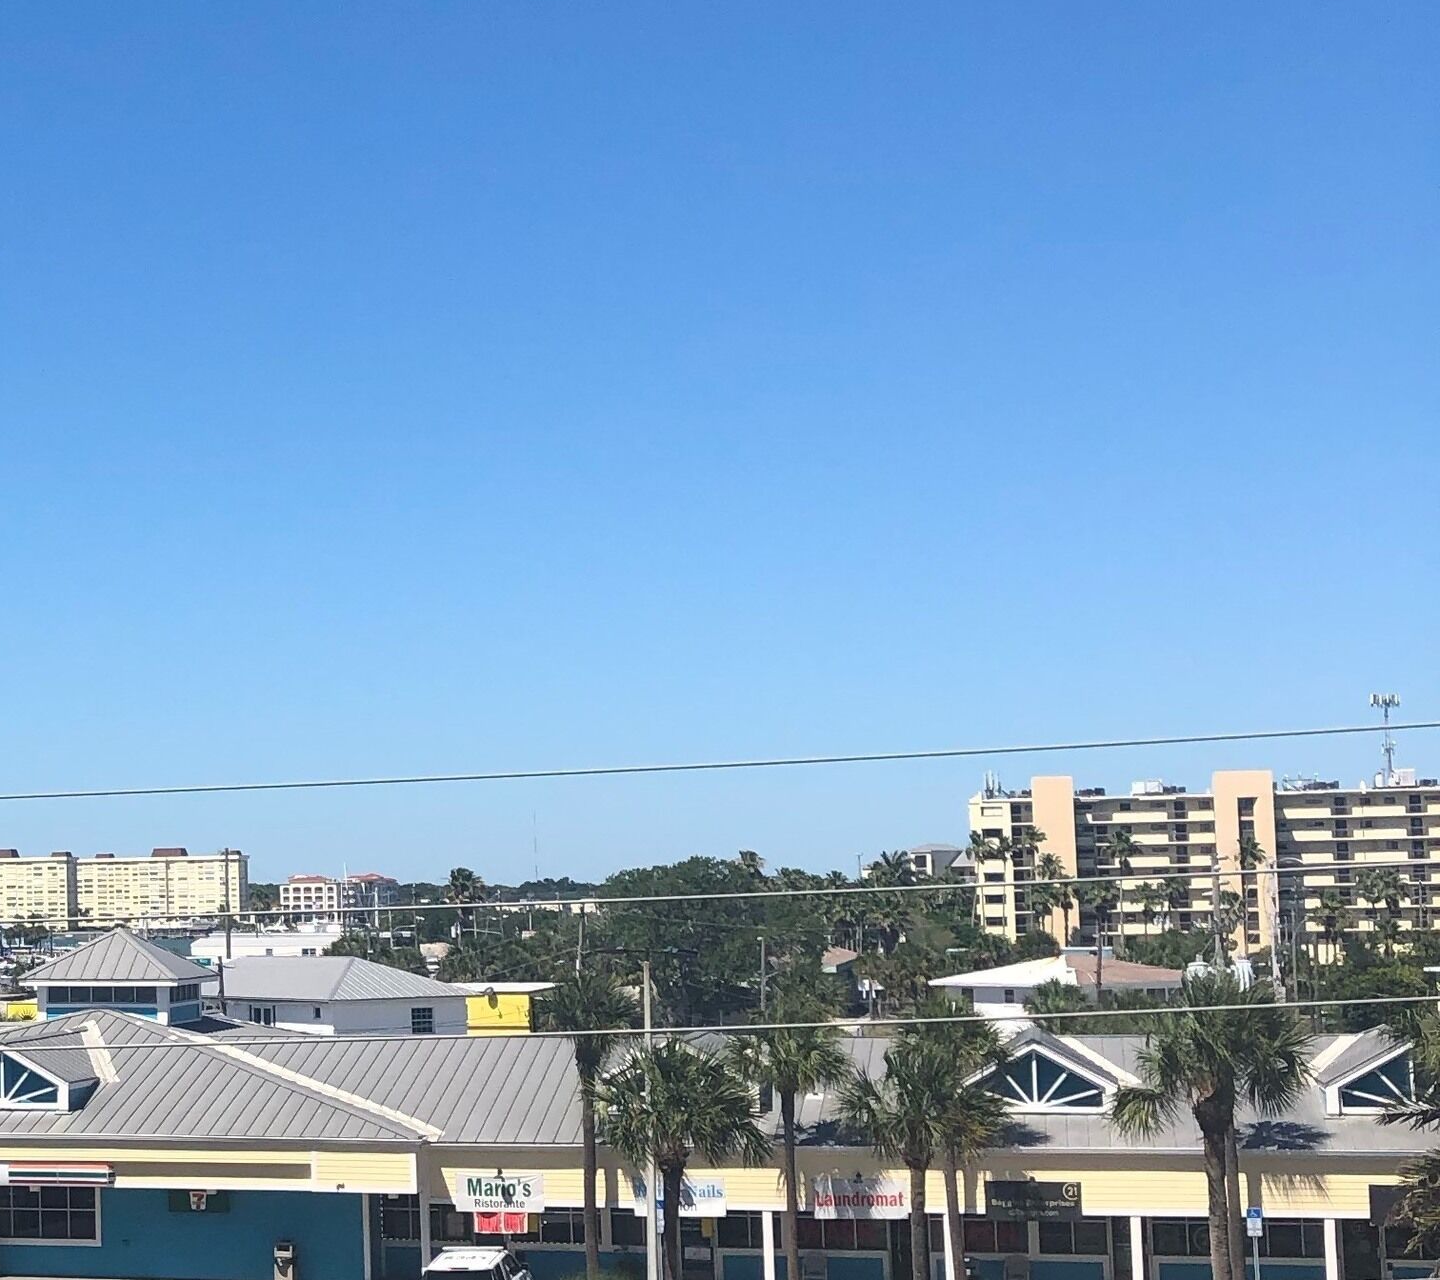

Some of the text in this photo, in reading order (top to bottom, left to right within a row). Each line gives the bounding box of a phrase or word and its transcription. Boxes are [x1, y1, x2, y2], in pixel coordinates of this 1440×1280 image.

[466, 1177, 532, 1198] Mario's
[474, 1199, 526, 1209] Ristorante
[816, 1191, 905, 1207] Laundromat
